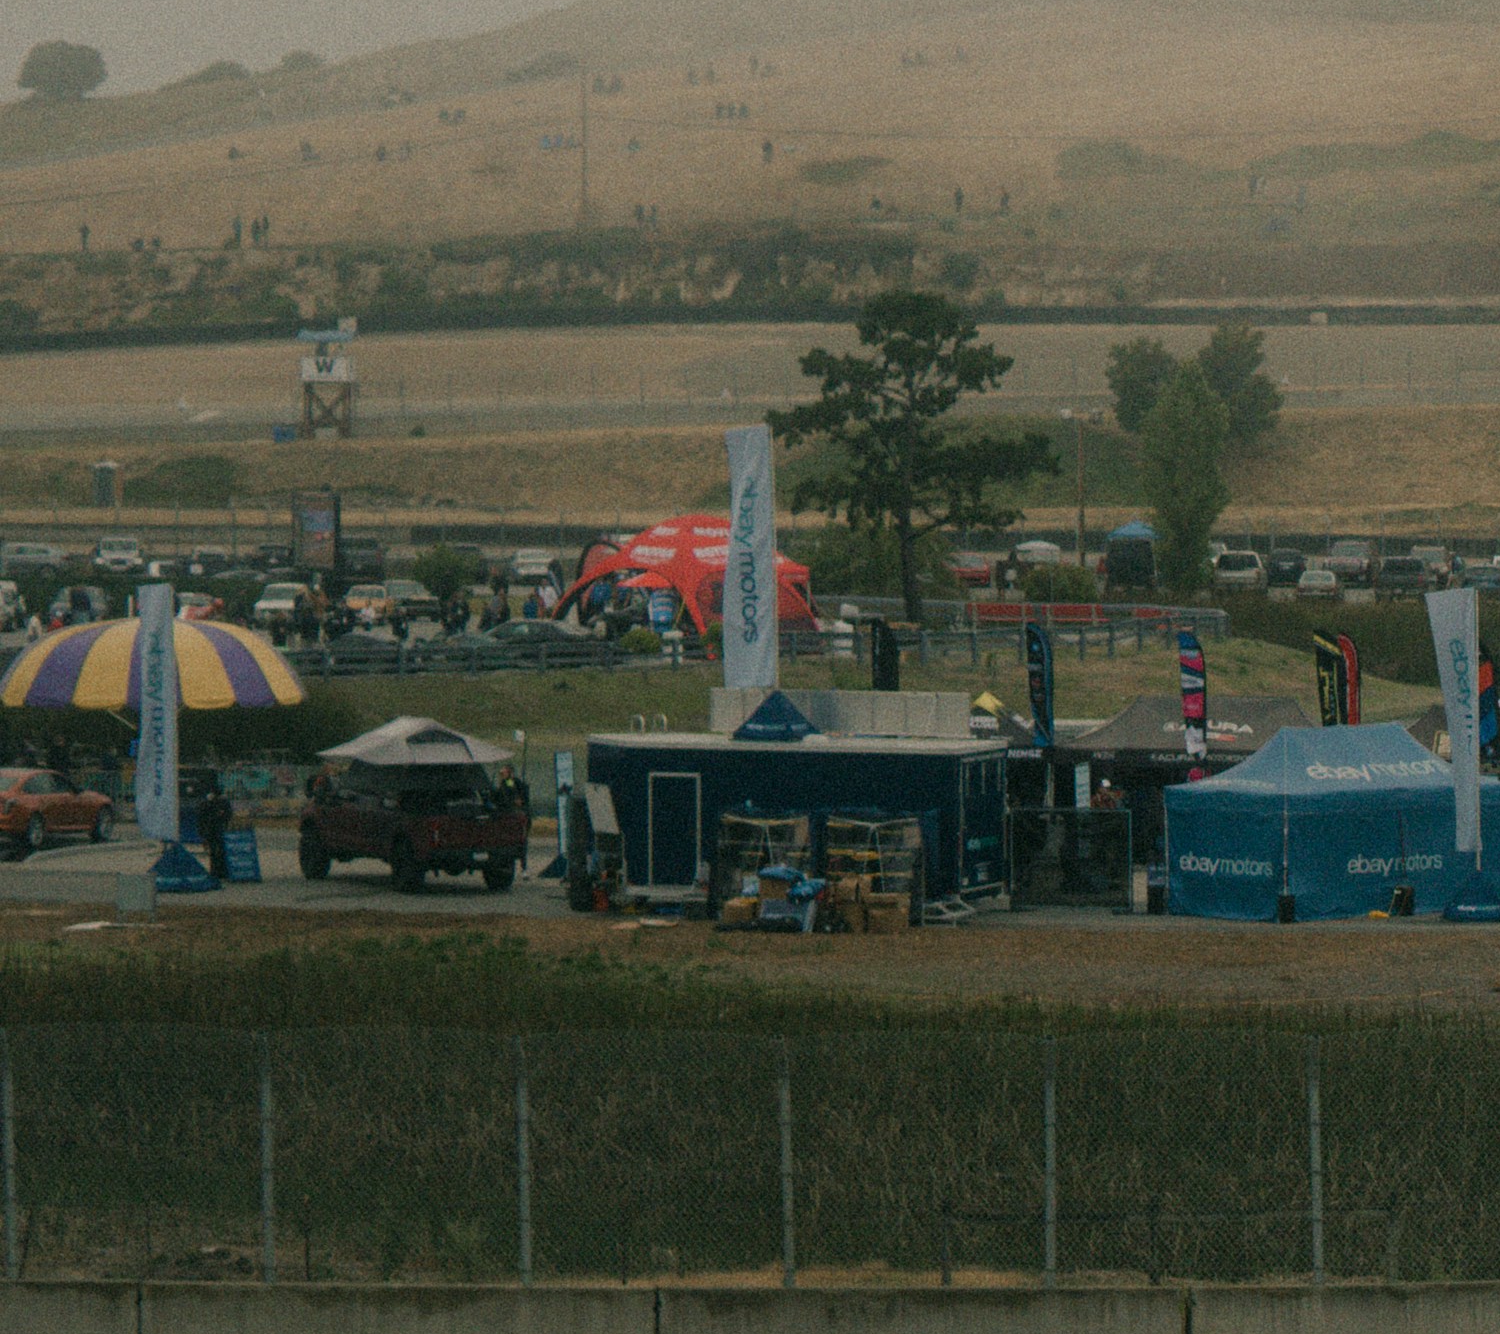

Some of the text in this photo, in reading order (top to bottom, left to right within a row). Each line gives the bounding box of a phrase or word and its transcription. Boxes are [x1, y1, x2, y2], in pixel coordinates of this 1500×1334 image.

[1306, 762, 1371, 781] ebay
[1179, 852, 1274, 877] ebay motors
[1348, 854, 1394, 876] ebay
